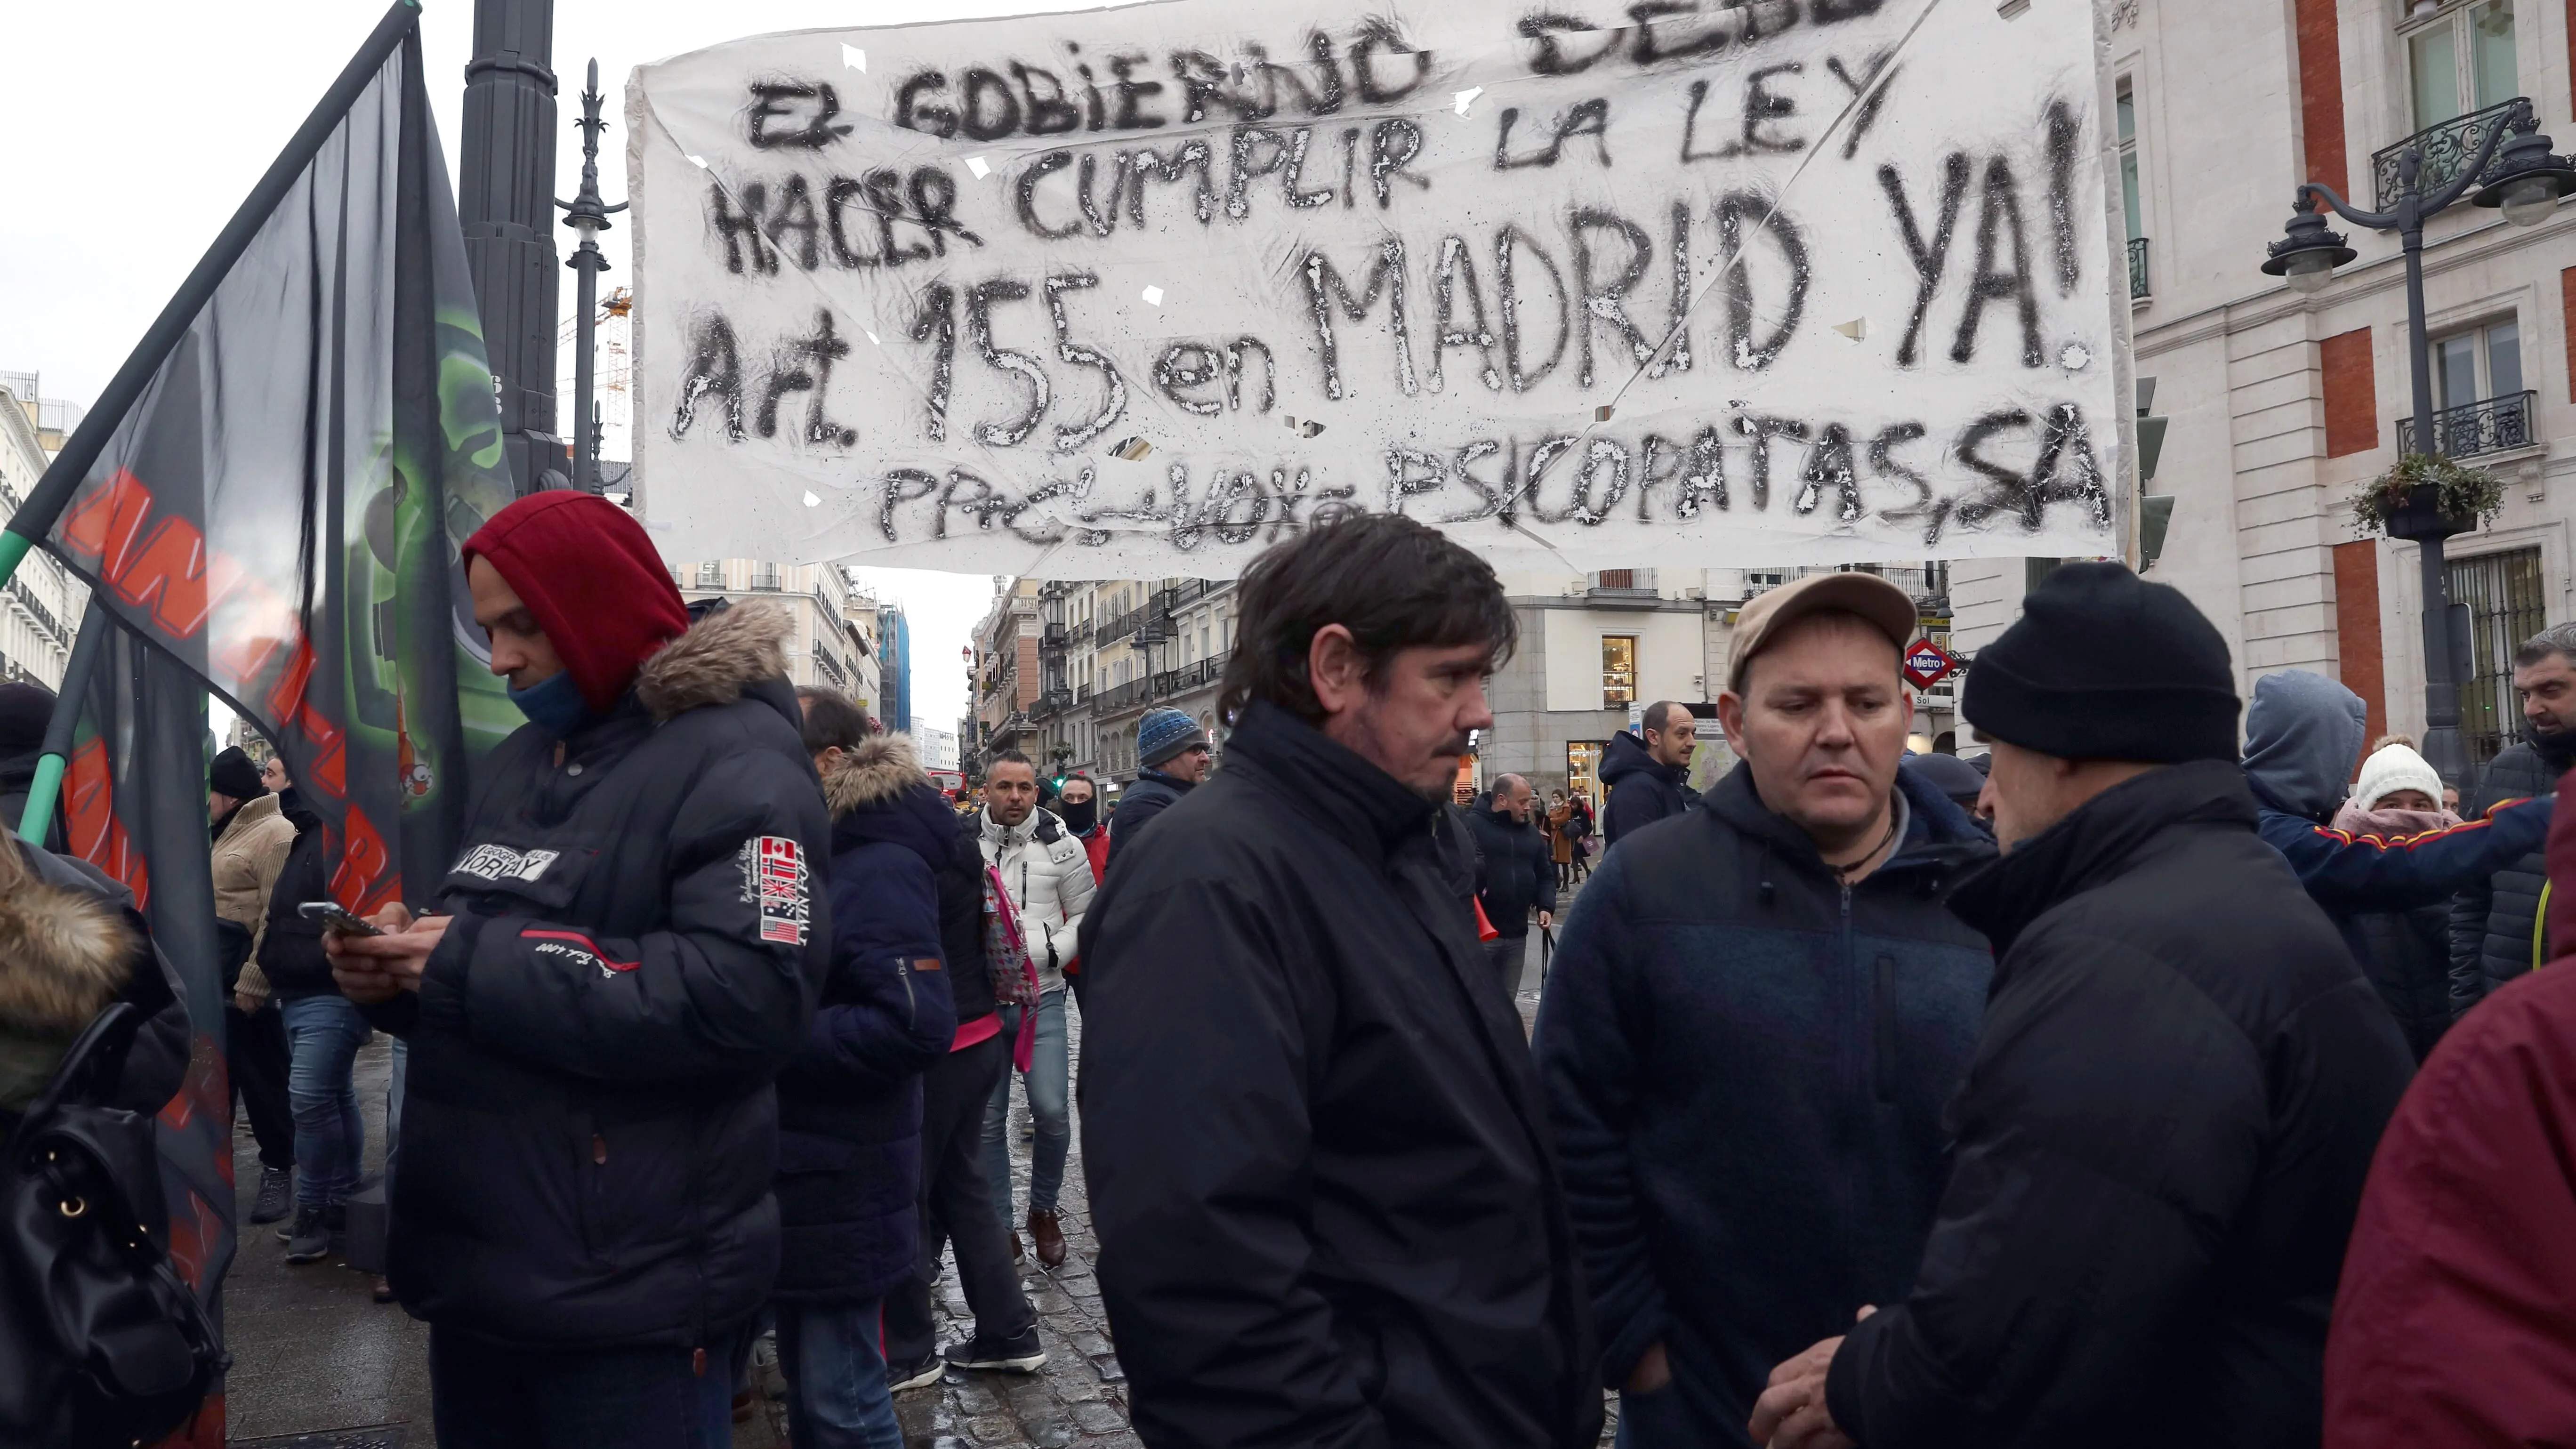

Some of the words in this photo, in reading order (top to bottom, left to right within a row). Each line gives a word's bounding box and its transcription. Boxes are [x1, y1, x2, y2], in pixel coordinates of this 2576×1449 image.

[709, 167, 985, 277] HACER
[1019, 119, 1430, 239] CUMPLIR
[1493, 98, 1612, 170] LA
[1681, 43, 1904, 163] LEY
[912, 272, 1128, 450] 155
[1153, 335, 1276, 415] en
[1304, 190, 1812, 402] MADRID
[1877, 97, 2093, 372] YA!
[1913, 657, 1940, 668] Metro
[1916, 696, 1929, 704] Sol
[797, 894, 811, 947] TWIN
